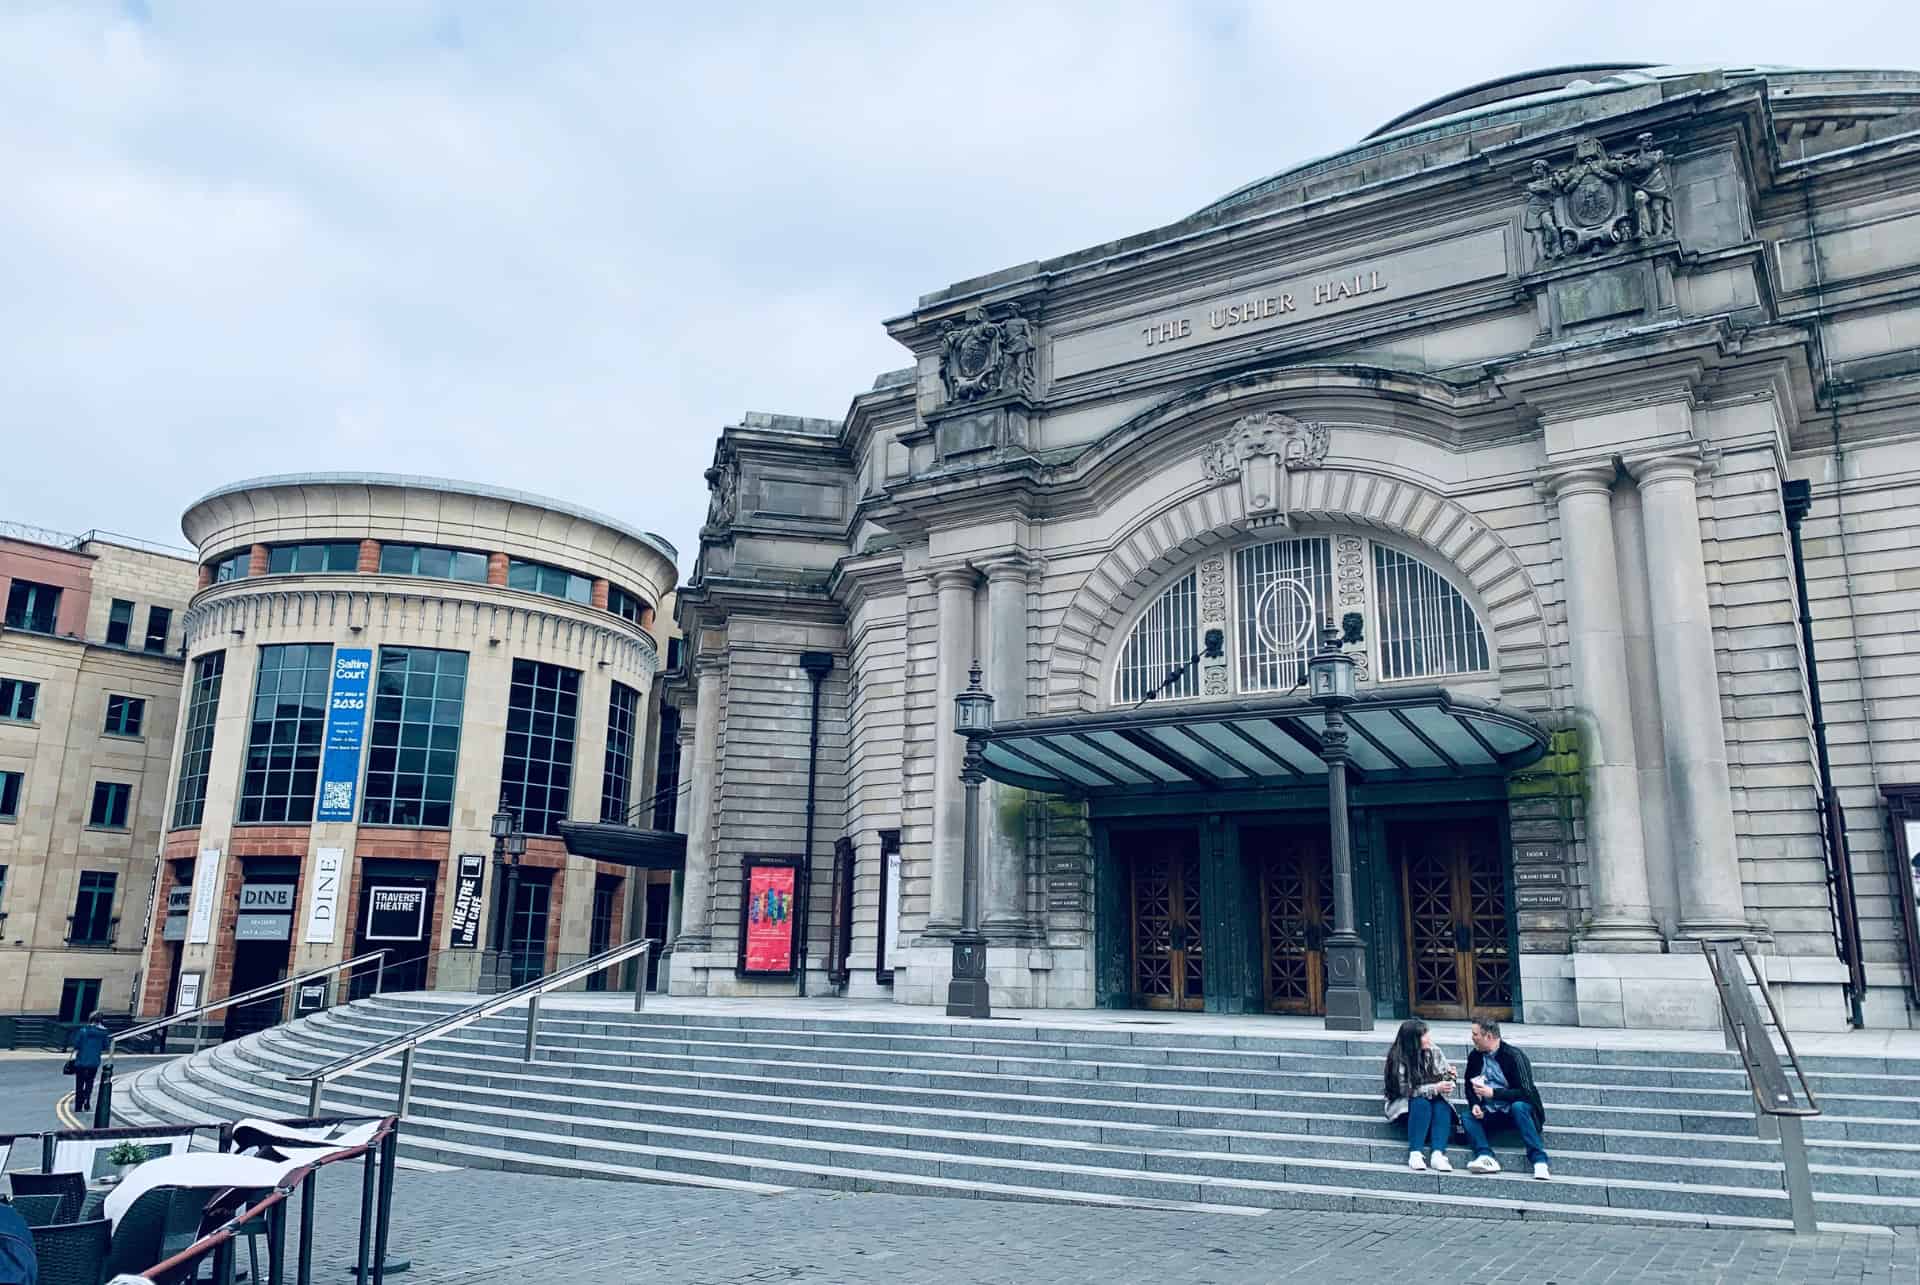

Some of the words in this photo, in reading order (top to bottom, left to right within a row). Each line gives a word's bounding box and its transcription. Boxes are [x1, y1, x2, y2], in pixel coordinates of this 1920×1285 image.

[1142, 319, 1193, 347] THE
[1209, 293, 1297, 331] USHER
[1312, 271, 1388, 306] HALL
[337, 657, 369, 670] Saltire
[336, 669, 365, 680] Court
[332, 698, 364, 710] 2030
[314, 859, 337, 921] DINE
[244, 890, 288, 905] DINE
[375, 892, 421, 903] TRAVERSE
[375, 901, 415, 912] THEATRE
[452, 879, 476, 931] THEATRE
[462, 920, 477, 942] BAR
